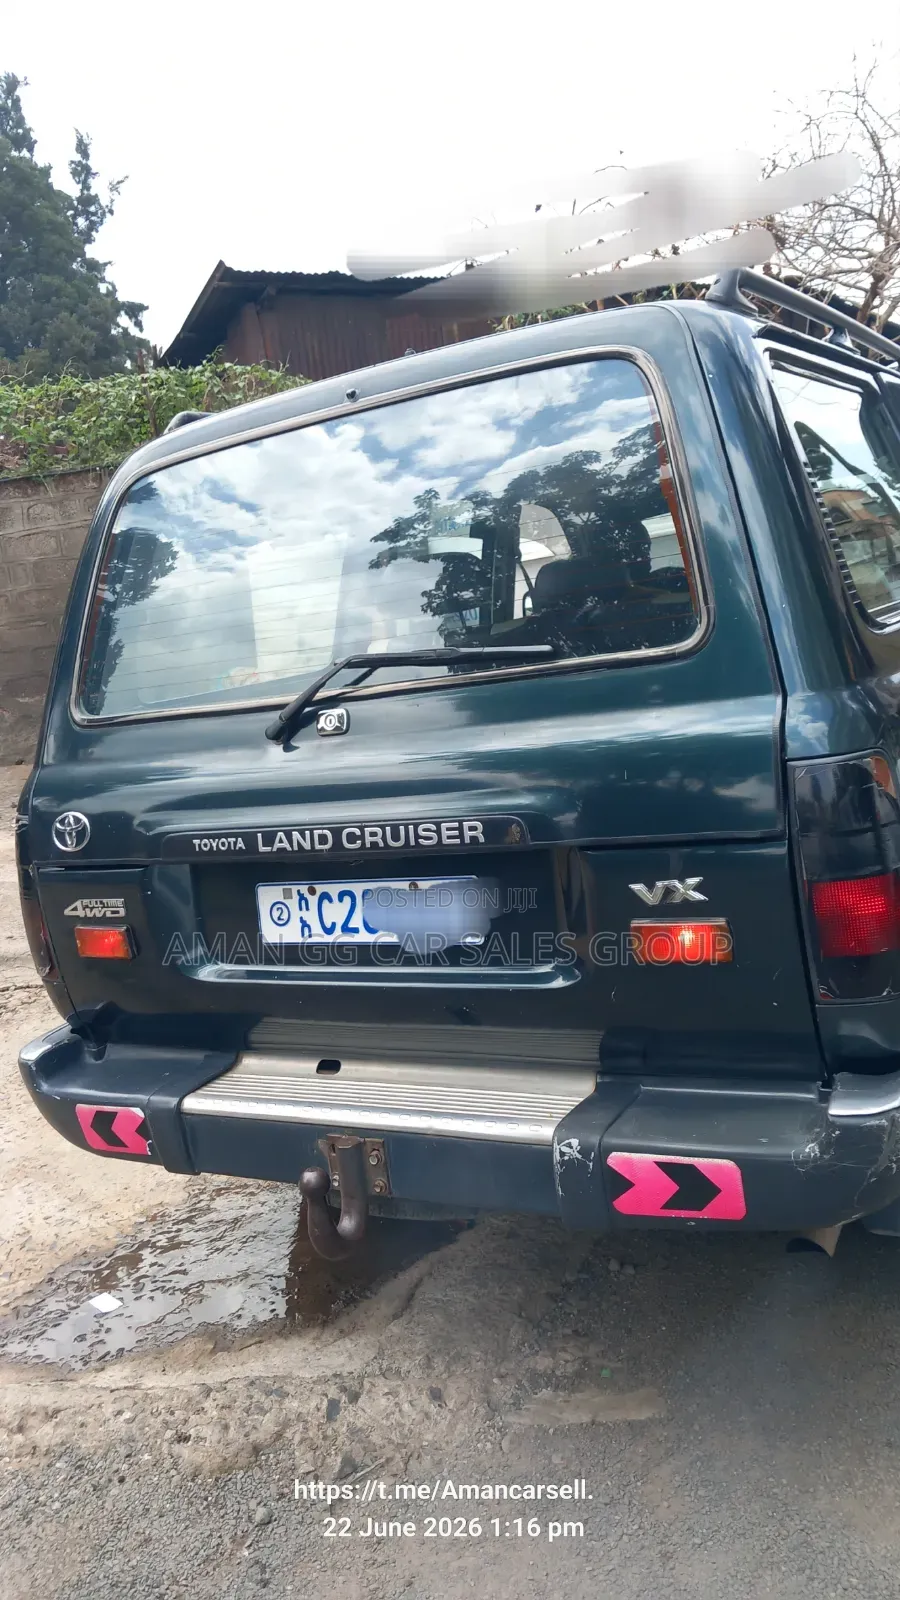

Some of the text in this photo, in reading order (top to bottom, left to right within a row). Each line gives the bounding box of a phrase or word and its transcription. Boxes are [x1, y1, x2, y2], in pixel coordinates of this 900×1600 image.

[193, 820, 485, 852] TOYOTA LAND CRUISER
[628, 876, 709, 906] VX
[64, 898, 125, 918] 4WD
[82, 900, 124, 908] FULL TIME
[276, 906, 285, 921] 2
